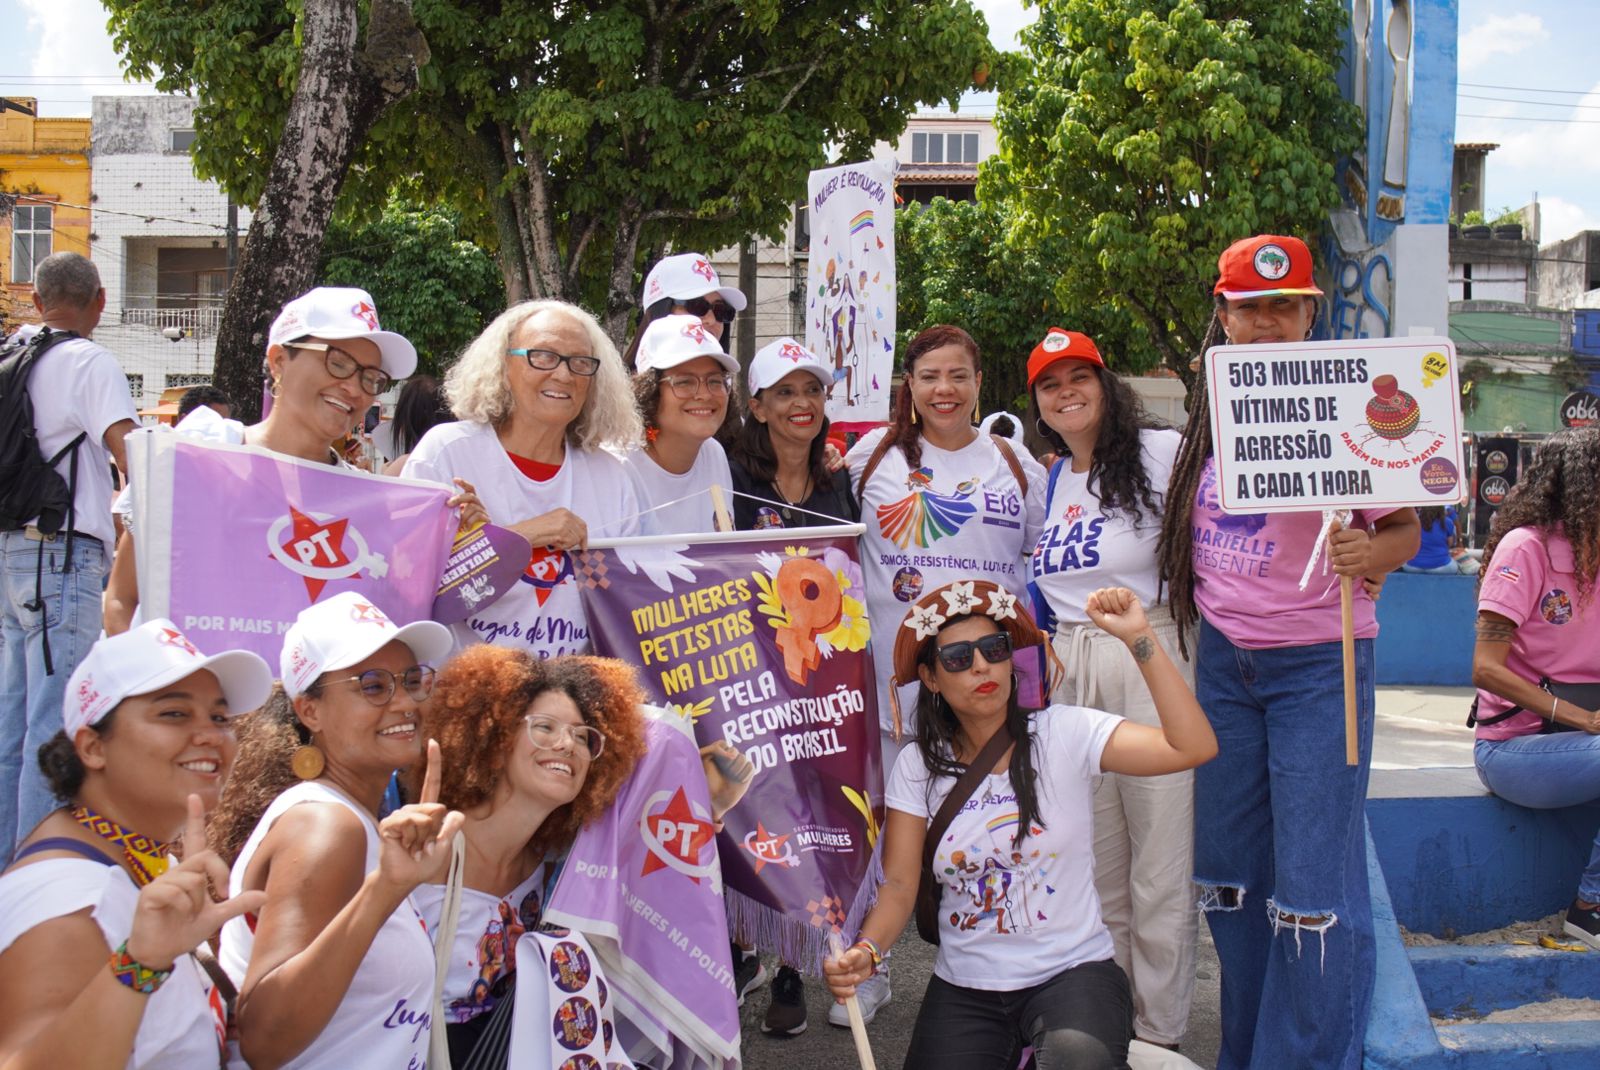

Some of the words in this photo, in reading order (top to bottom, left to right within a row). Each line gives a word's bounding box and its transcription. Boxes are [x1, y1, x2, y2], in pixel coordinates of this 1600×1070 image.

[814, 175, 838, 213] MULHER
[1228, 361, 1267, 387] 503
[1271, 358, 1368, 386] MULHERES
[1231, 394, 1311, 424] VÍTIMAS
[1314, 396, 1338, 422] DE
[1234, 429, 1332, 462] AGRESSÃO
[1340, 431, 1370, 462] PAREM
[1370, 457, 1384, 468] DE
[1387, 459, 1410, 469] NOS
[1237, 474, 1250, 499] A
[1253, 472, 1305, 498] CADA
[1307, 471, 1317, 496] 1
[1321, 470, 1373, 496] HORA
[1423, 476, 1457, 485] NEGRA
[983, 491, 1020, 517] EIG
[293, 529, 338, 566] PT
[1037, 517, 1106, 549] ELAS
[1191, 526, 1276, 558] MARIELLE
[441, 545, 497, 585] MULHER
[446, 536, 491, 570] INSUBM
[531, 554, 562, 581] PT
[880, 553, 910, 566] SOMOS:
[913, 555, 979, 572] RESISTÊNCIA,
[1033, 540, 1100, 577] ELAS
[631, 578, 752, 635] MULHERES
[184, 615, 224, 631] POR
[229, 617, 273, 634] MAIS
[466, 618, 522, 644] ugar
[526, 615, 545, 645] de
[640, 608, 755, 666] PETISTAS
[661, 662, 695, 696] NA
[698, 641, 758, 686] LUTA
[719, 670, 776, 712] PELA
[721, 684, 865, 748] RECONSTRUÇÃO
[745, 741, 777, 776] DO
[780, 727, 847, 763] BRASIL
[656, 820, 699, 858] PT
[755, 839, 778, 857] PT
[796, 831, 852, 846] MULHERES
[574, 860, 608, 879] POR
[668, 927, 689, 952] NA
